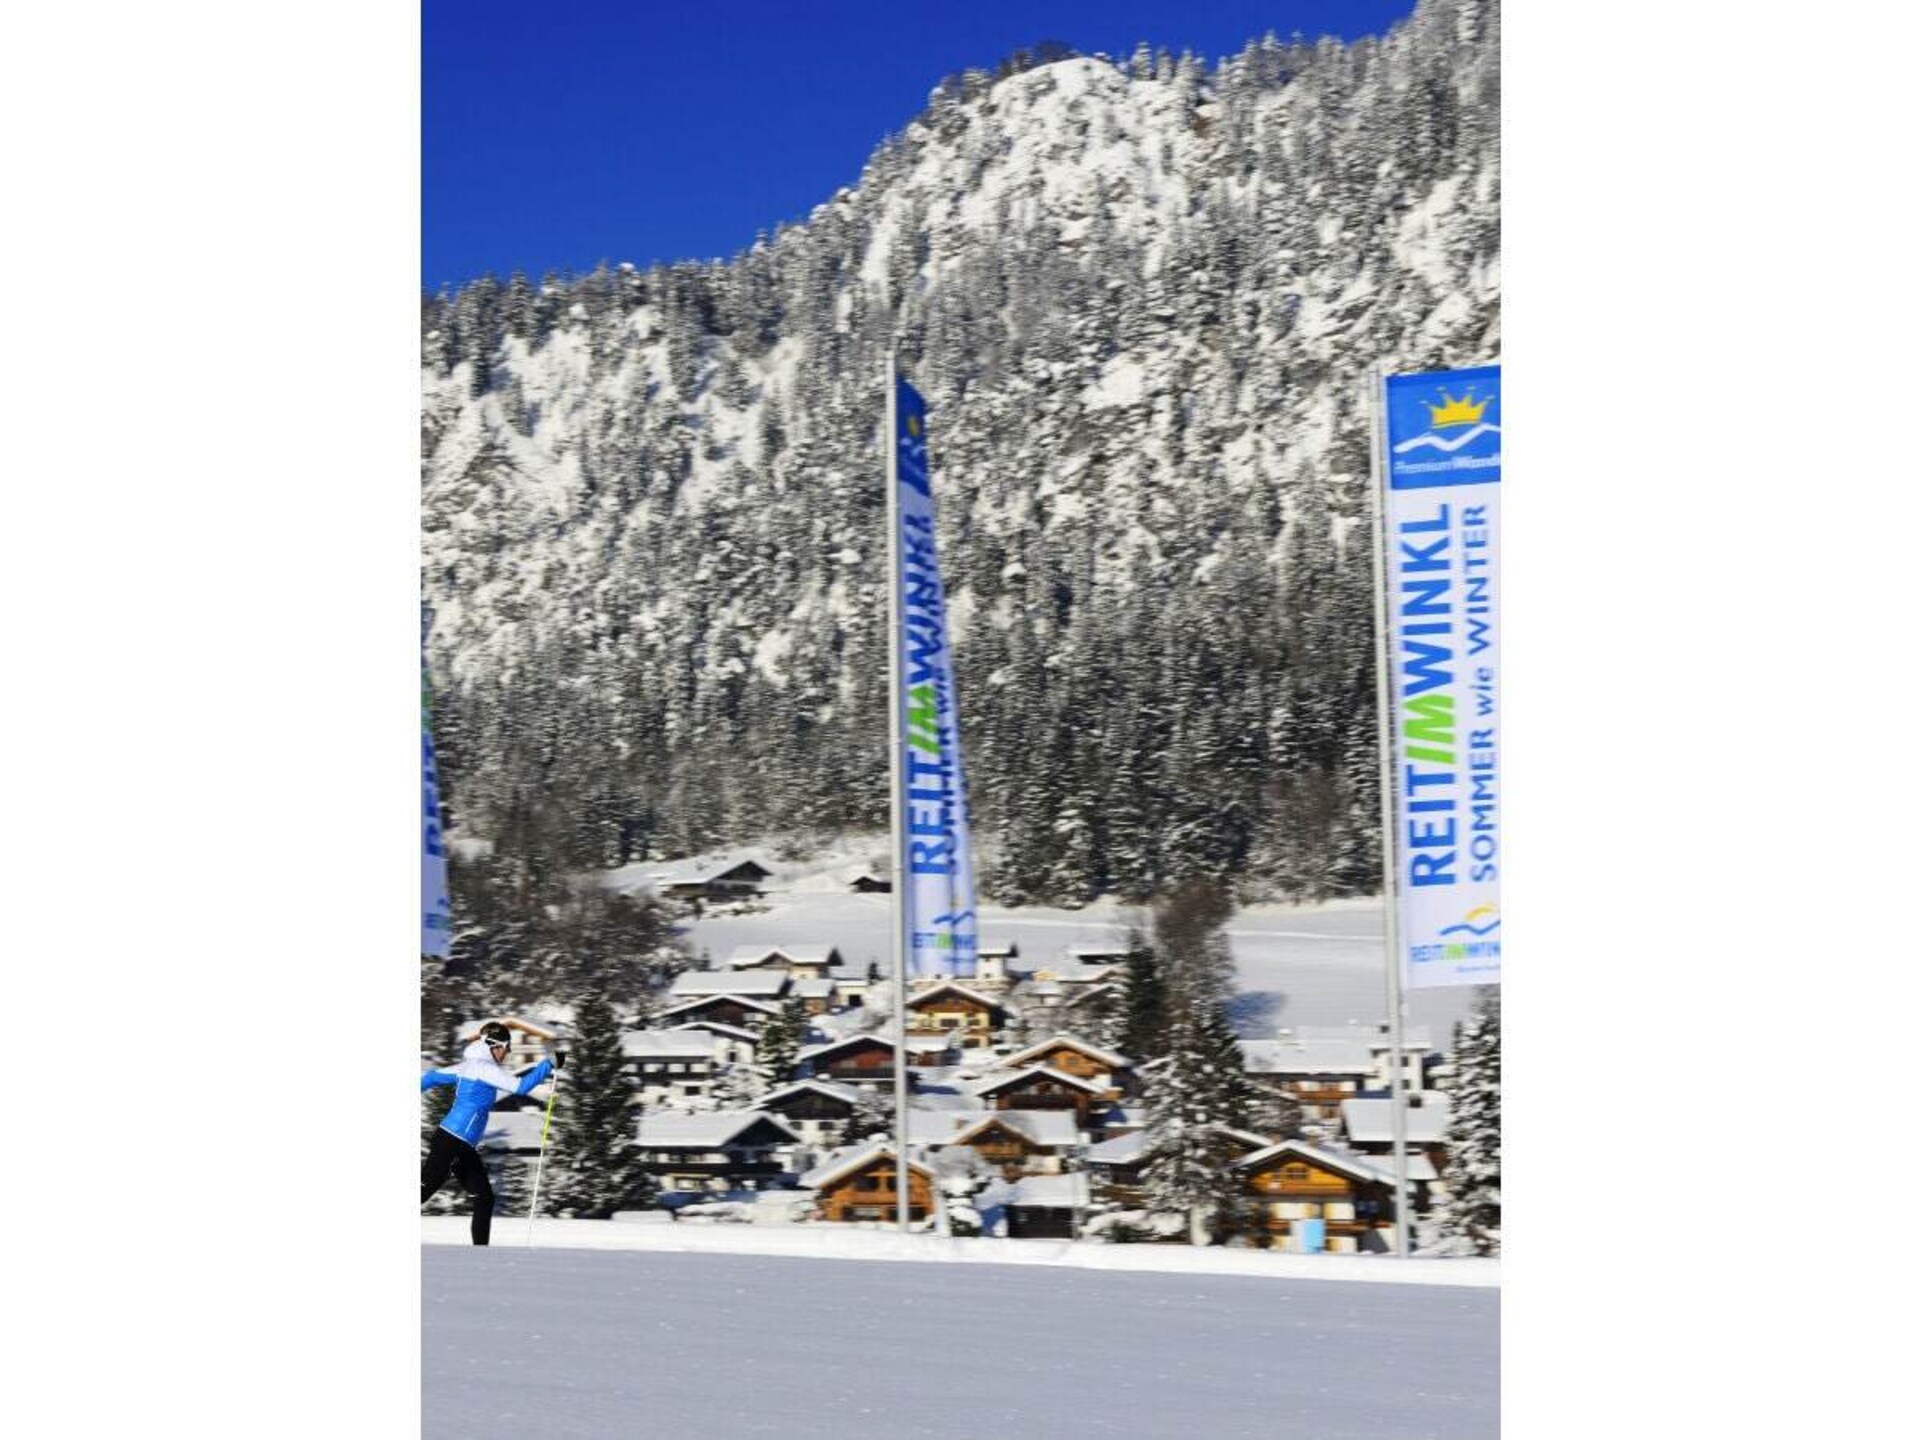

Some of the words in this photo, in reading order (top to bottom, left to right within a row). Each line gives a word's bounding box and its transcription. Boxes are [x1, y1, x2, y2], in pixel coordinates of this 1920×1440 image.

[1462, 505, 1490, 656] WINTER
[1400, 503, 1456, 886] REITIMWINKL
[1472, 667, 1495, 717] wie
[1469, 728, 1498, 882] SOMMER
